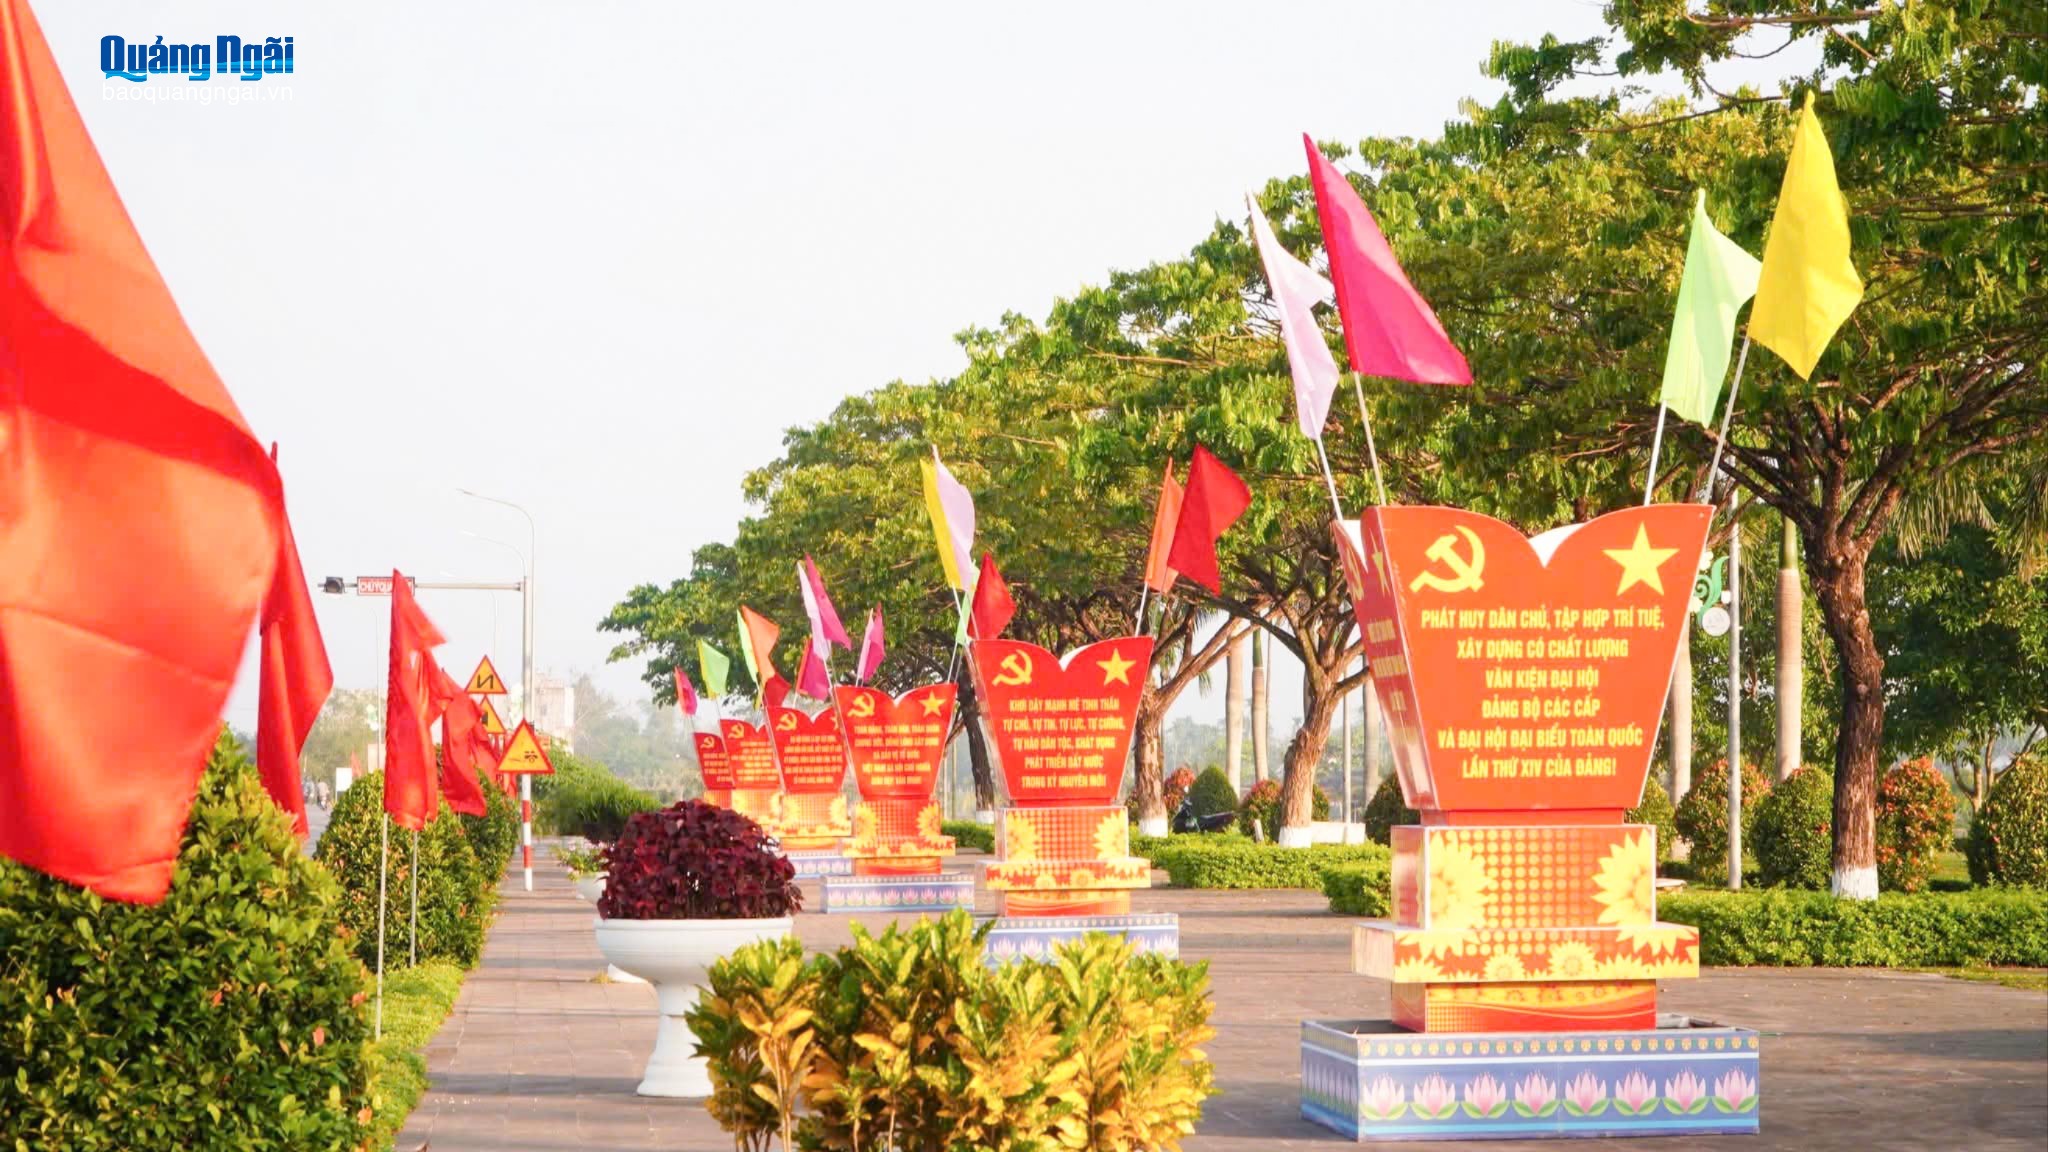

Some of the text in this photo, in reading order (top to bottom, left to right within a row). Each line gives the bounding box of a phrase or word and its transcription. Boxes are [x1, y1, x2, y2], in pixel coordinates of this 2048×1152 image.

[1421, 606, 1456, 629] PHÁT
[1459, 610, 1485, 629] HUY
[1488, 606, 1517, 629] DÂN
[1554, 606, 1580, 632] TẬP
[1583, 609, 1610, 632] HỢP
[1613, 605, 1634, 628] TRÍ
[1457, 634, 1629, 662] XÂY DỰNG CÓ CHẤT LƯỢNG
[1486, 665, 1599, 692] VĂN KIỆN ĐẠI HỘI
[1482, 694, 1601, 721] ĐẢNG BỘ CÁC CẤP
[1438, 722, 1644, 752] VÀ ĐẠI HỘI ĐẠI BIỂU TOÀN QUỐC
[1462, 753, 1617, 779] LẦN THỨ XIV CỦA ĐẢNG!
